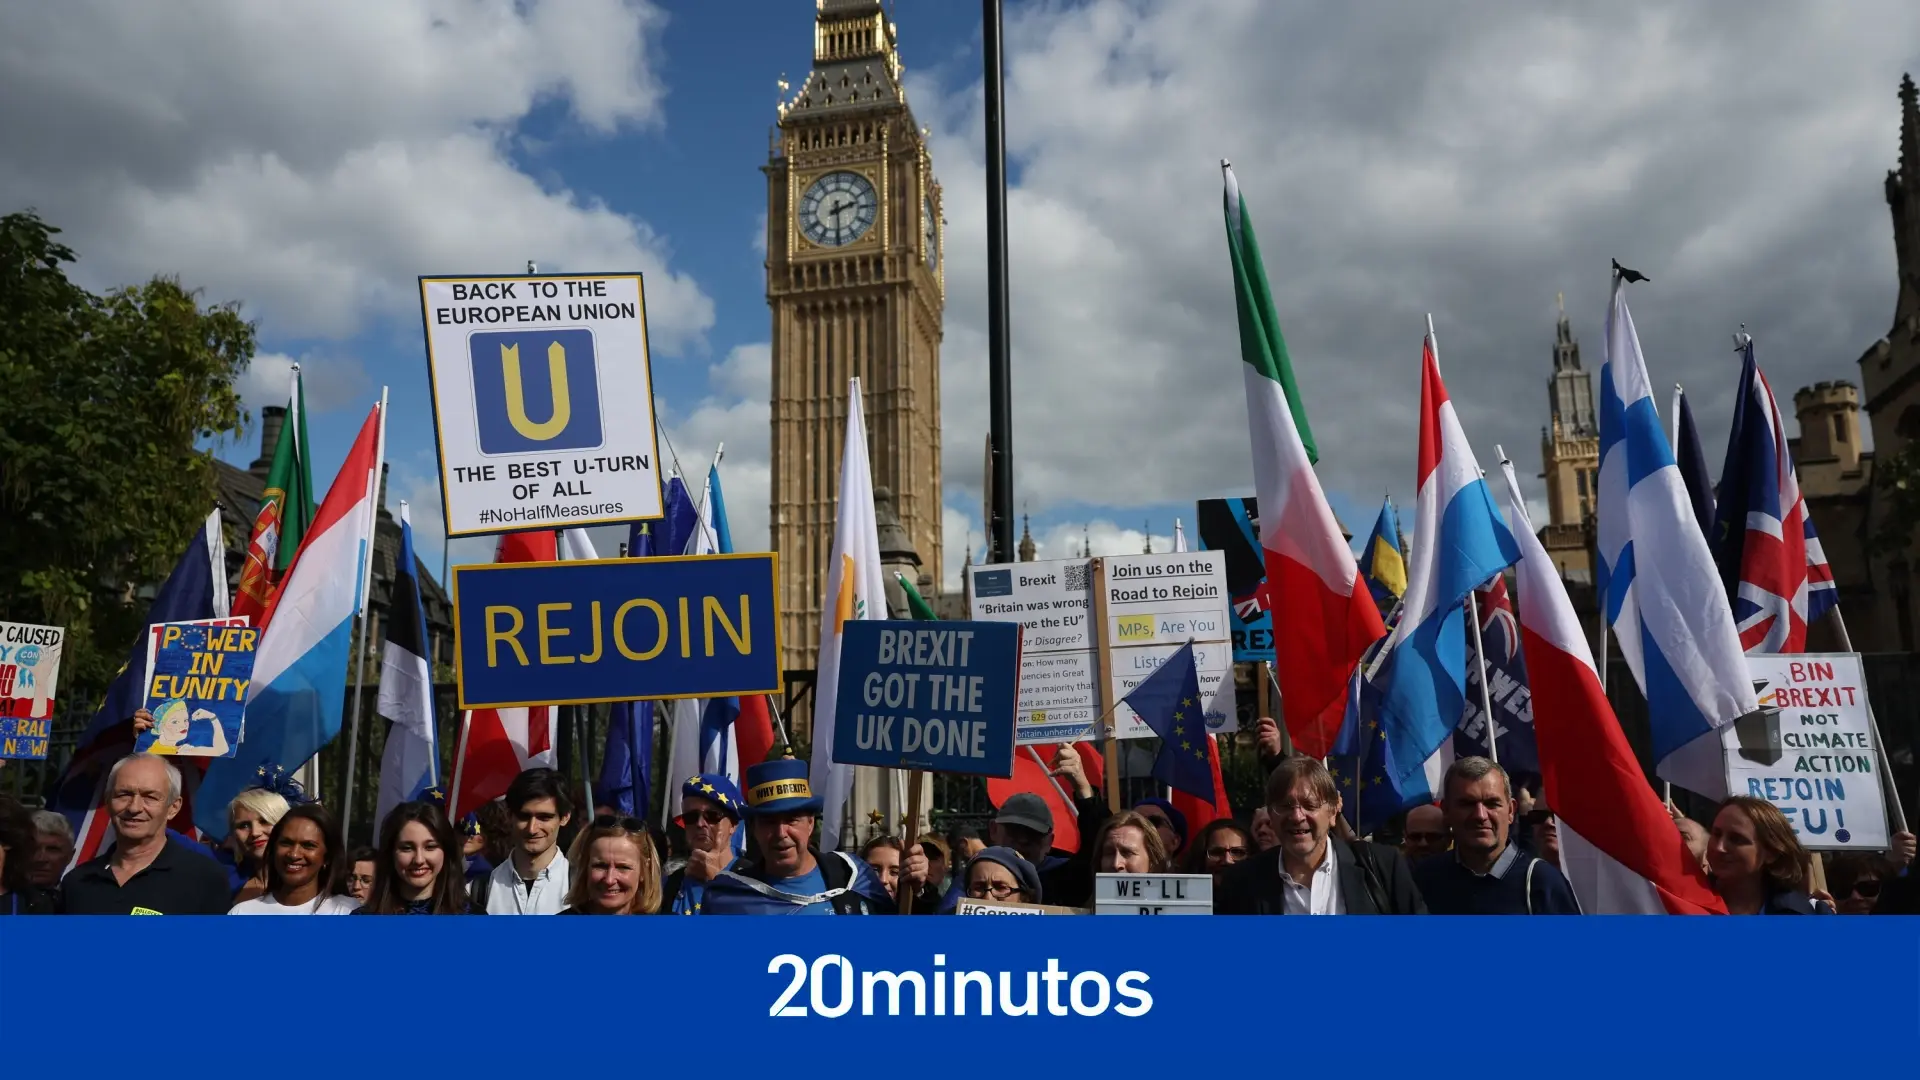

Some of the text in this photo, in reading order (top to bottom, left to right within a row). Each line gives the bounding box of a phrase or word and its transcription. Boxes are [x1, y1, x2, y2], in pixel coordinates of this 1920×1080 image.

[452, 281, 607, 300] BACK TO THE
[436, 303, 636, 325] EUROPEAN UNION
[453, 454, 649, 483] THE BEST U-TURN
[512, 480, 592, 500] OF ALL
[479, 501, 624, 524] #NoHalfMeasures
[1112, 560, 1213, 578] Join us on the
[1020, 574, 1057, 587] Brexit
[1110, 583, 1218, 602] Road to Rejoin
[1026, 601, 1050, 611] was
[1052, 598, 1089, 609] wrong
[485, 594, 751, 667] REJOIN
[1040, 618, 1060, 628] the
[1118, 619, 1215, 638] MPs, Are You
[7, 626, 60, 646] CAUSED
[162, 626, 257, 652] POWER
[1035, 634, 1083, 647] Disagree?
[878, 630, 974, 667] BREXIT
[187, 652, 224, 675] IN
[1022, 658, 1078, 668] on: How many
[1790, 662, 1834, 683] BIN
[1021, 669, 1085, 681] uencies in Great
[1200, 675, 1221, 684] have
[150, 675, 250, 701] EUNITY
[863, 672, 984, 713] GOT THE
[1019, 687, 1034, 695] ave
[1041, 683, 1075, 693] majority
[1076, 682, 1095, 690] that
[1775, 686, 1856, 708] BREXIT
[1019, 699, 1034, 708] exit
[1052, 695, 1088, 705] mistake?
[1031, 713, 1046, 722] 629
[1063, 711, 1072, 719] of
[1073, 710, 1088, 719] 632
[1800, 714, 1839, 726] NOT
[855, 714, 987, 758] UK DONE
[1783, 732, 1869, 748] CLIMATE
[1794, 755, 1871, 773] ACTION
[756, 783, 807, 798] WHY BREXIT?
[1747, 777, 1845, 801] REJOIN
[1778, 807, 1851, 843] EU!
